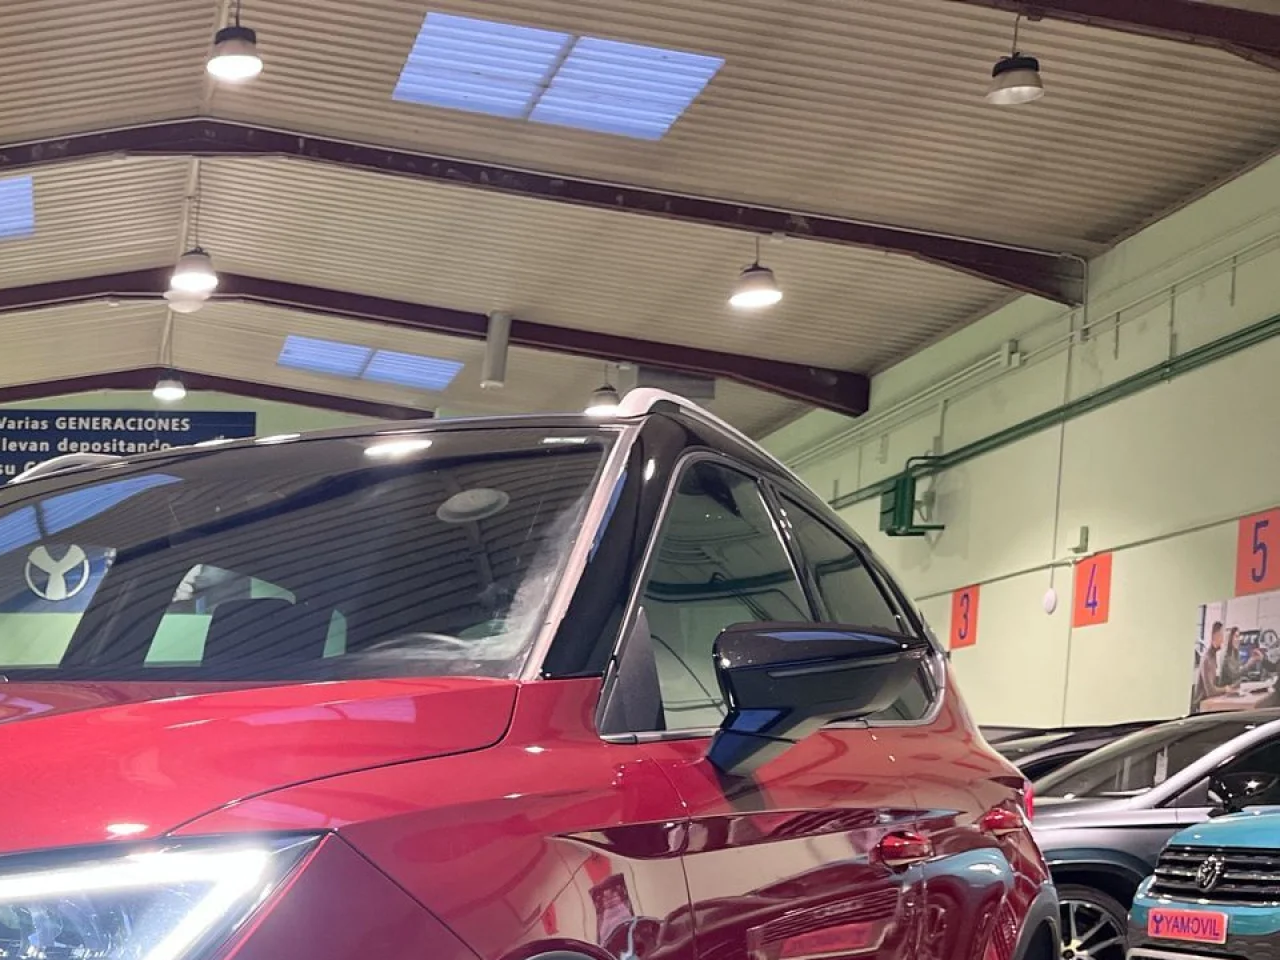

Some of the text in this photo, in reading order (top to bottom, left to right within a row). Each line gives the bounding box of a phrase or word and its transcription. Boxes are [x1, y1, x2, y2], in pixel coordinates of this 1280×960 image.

[55, 416, 191, 431] GENERACIONES
[1251, 520, 1269, 582] 5
[1085, 563, 1098, 616] 4
[958, 593, 970, 640] 3
[1164, 916, 1220, 937] YAMOVIL
